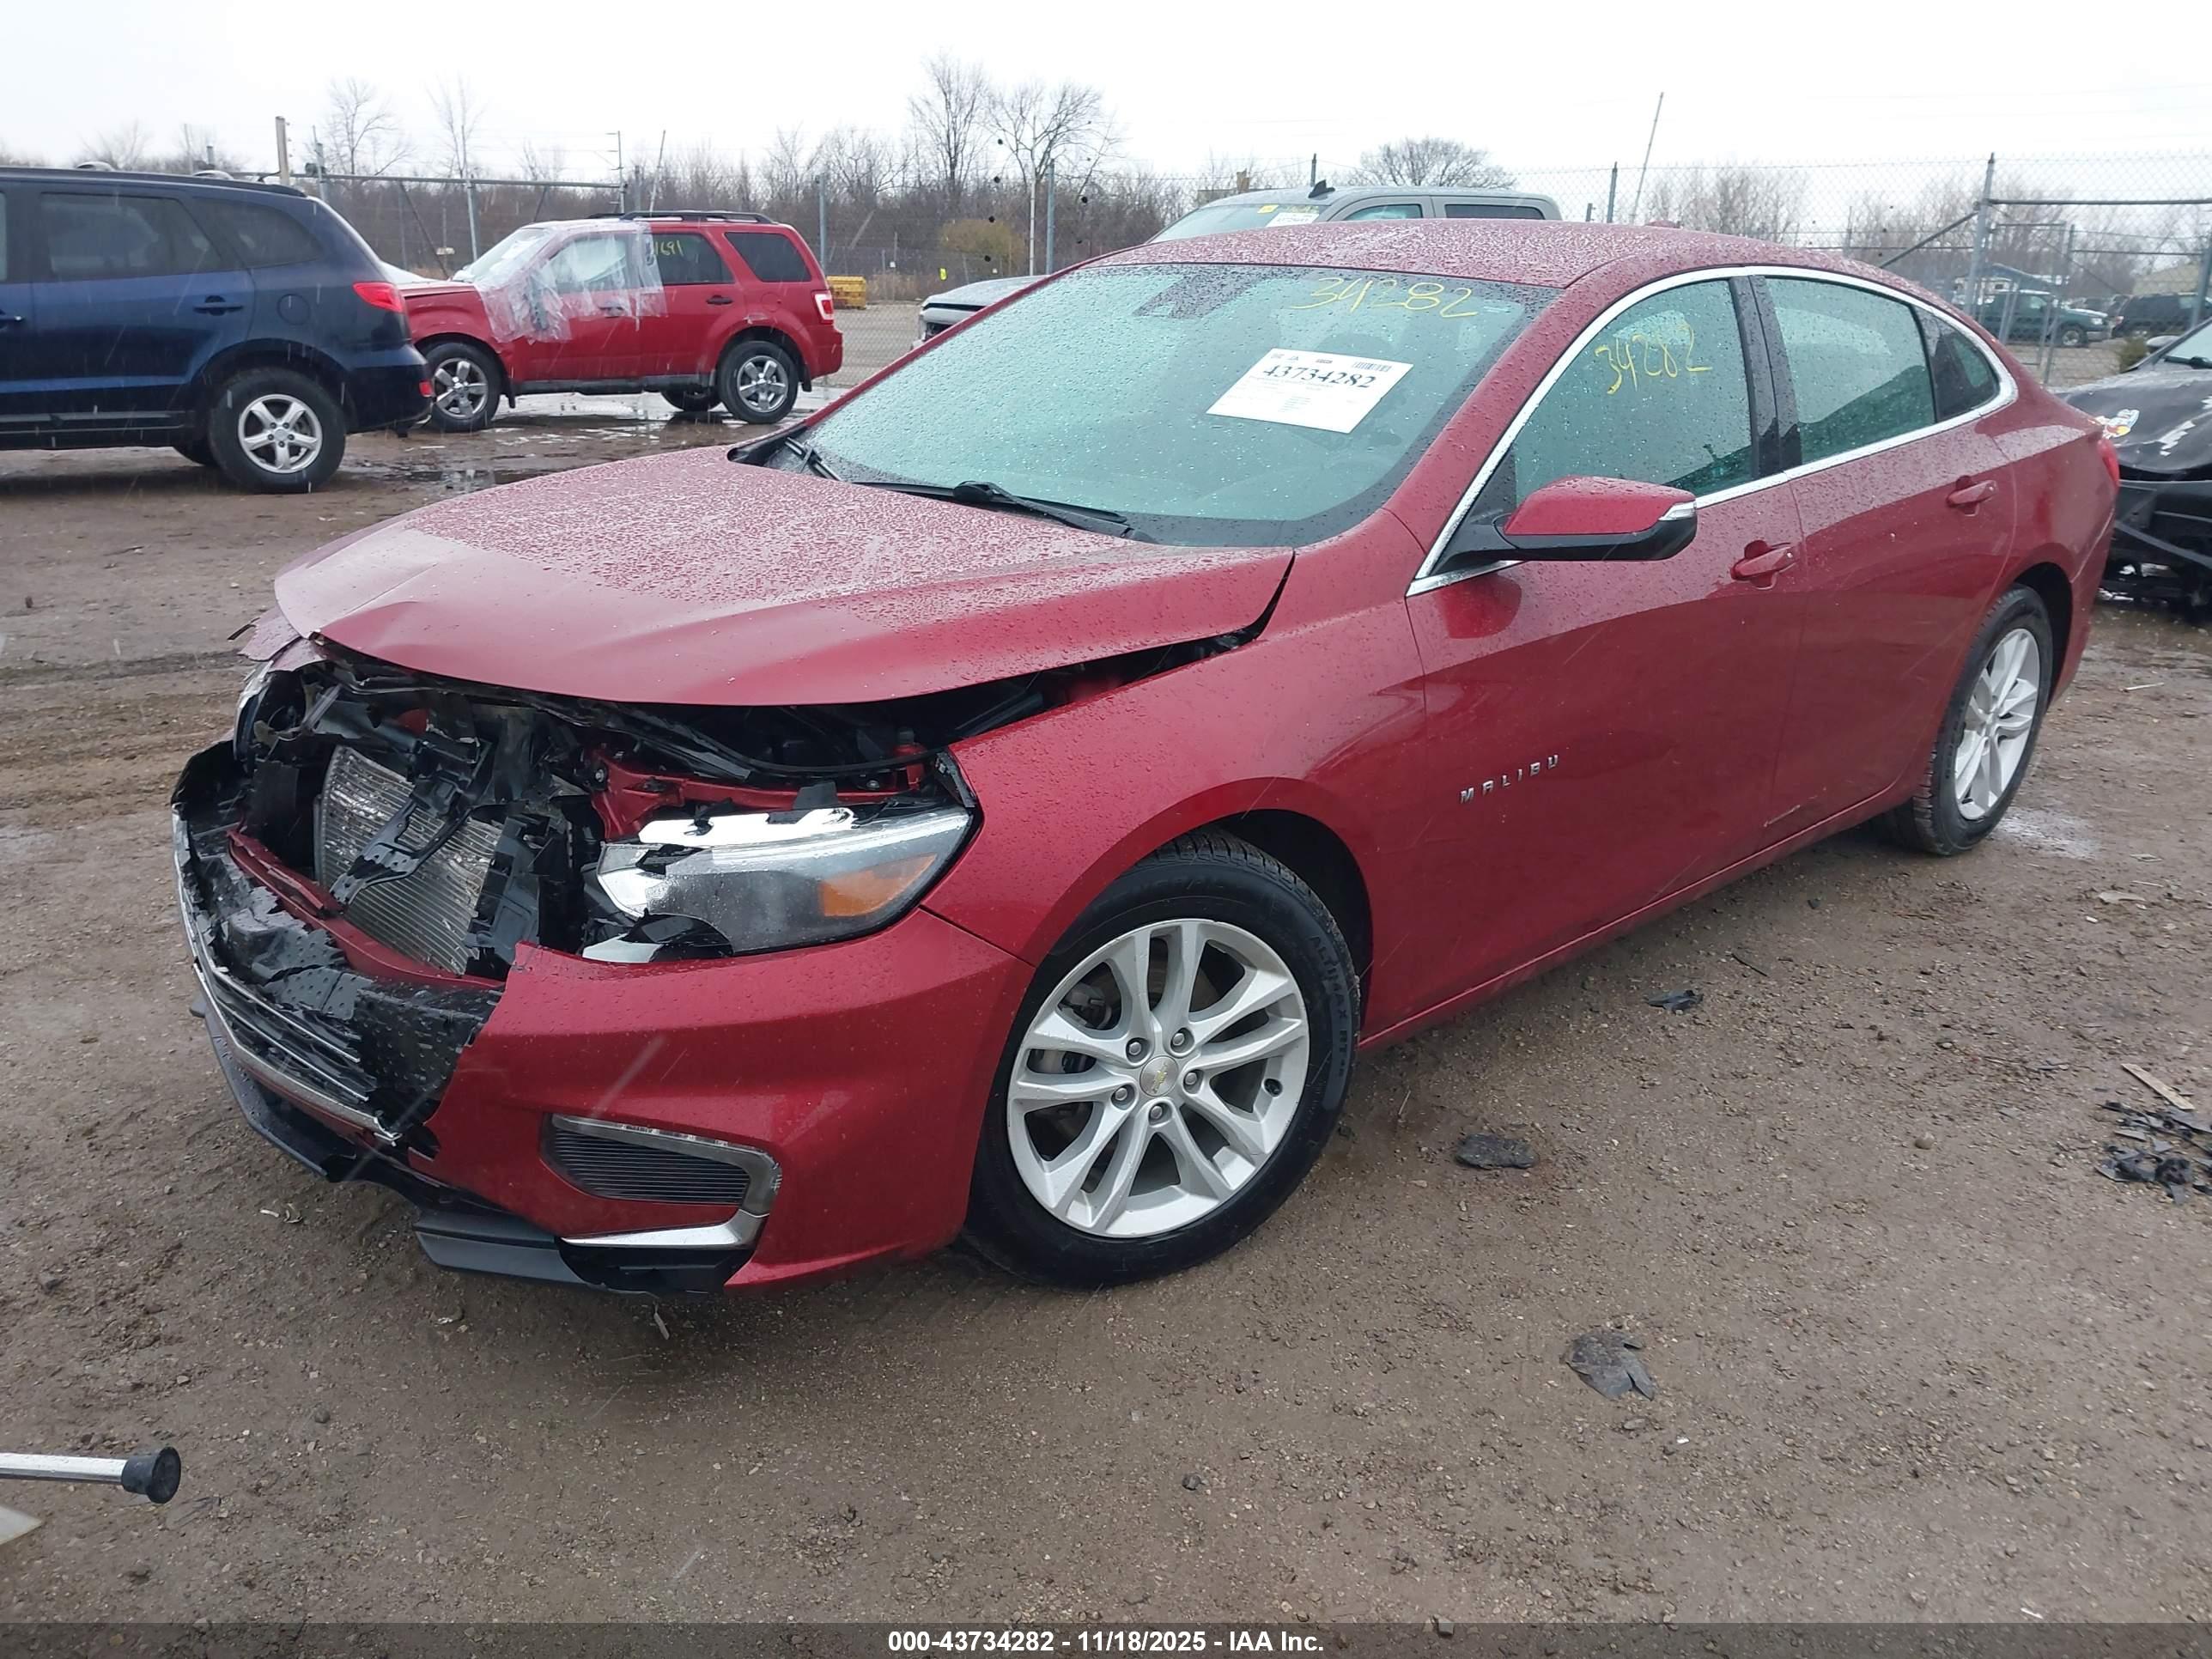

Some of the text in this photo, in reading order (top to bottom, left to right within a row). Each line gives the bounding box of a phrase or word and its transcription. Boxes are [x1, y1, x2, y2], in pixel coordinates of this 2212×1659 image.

[1291, 277, 1478, 318] 34282
[1263, 364, 1376, 388] 43734282
[1460, 754, 1559, 804] MALIBU
